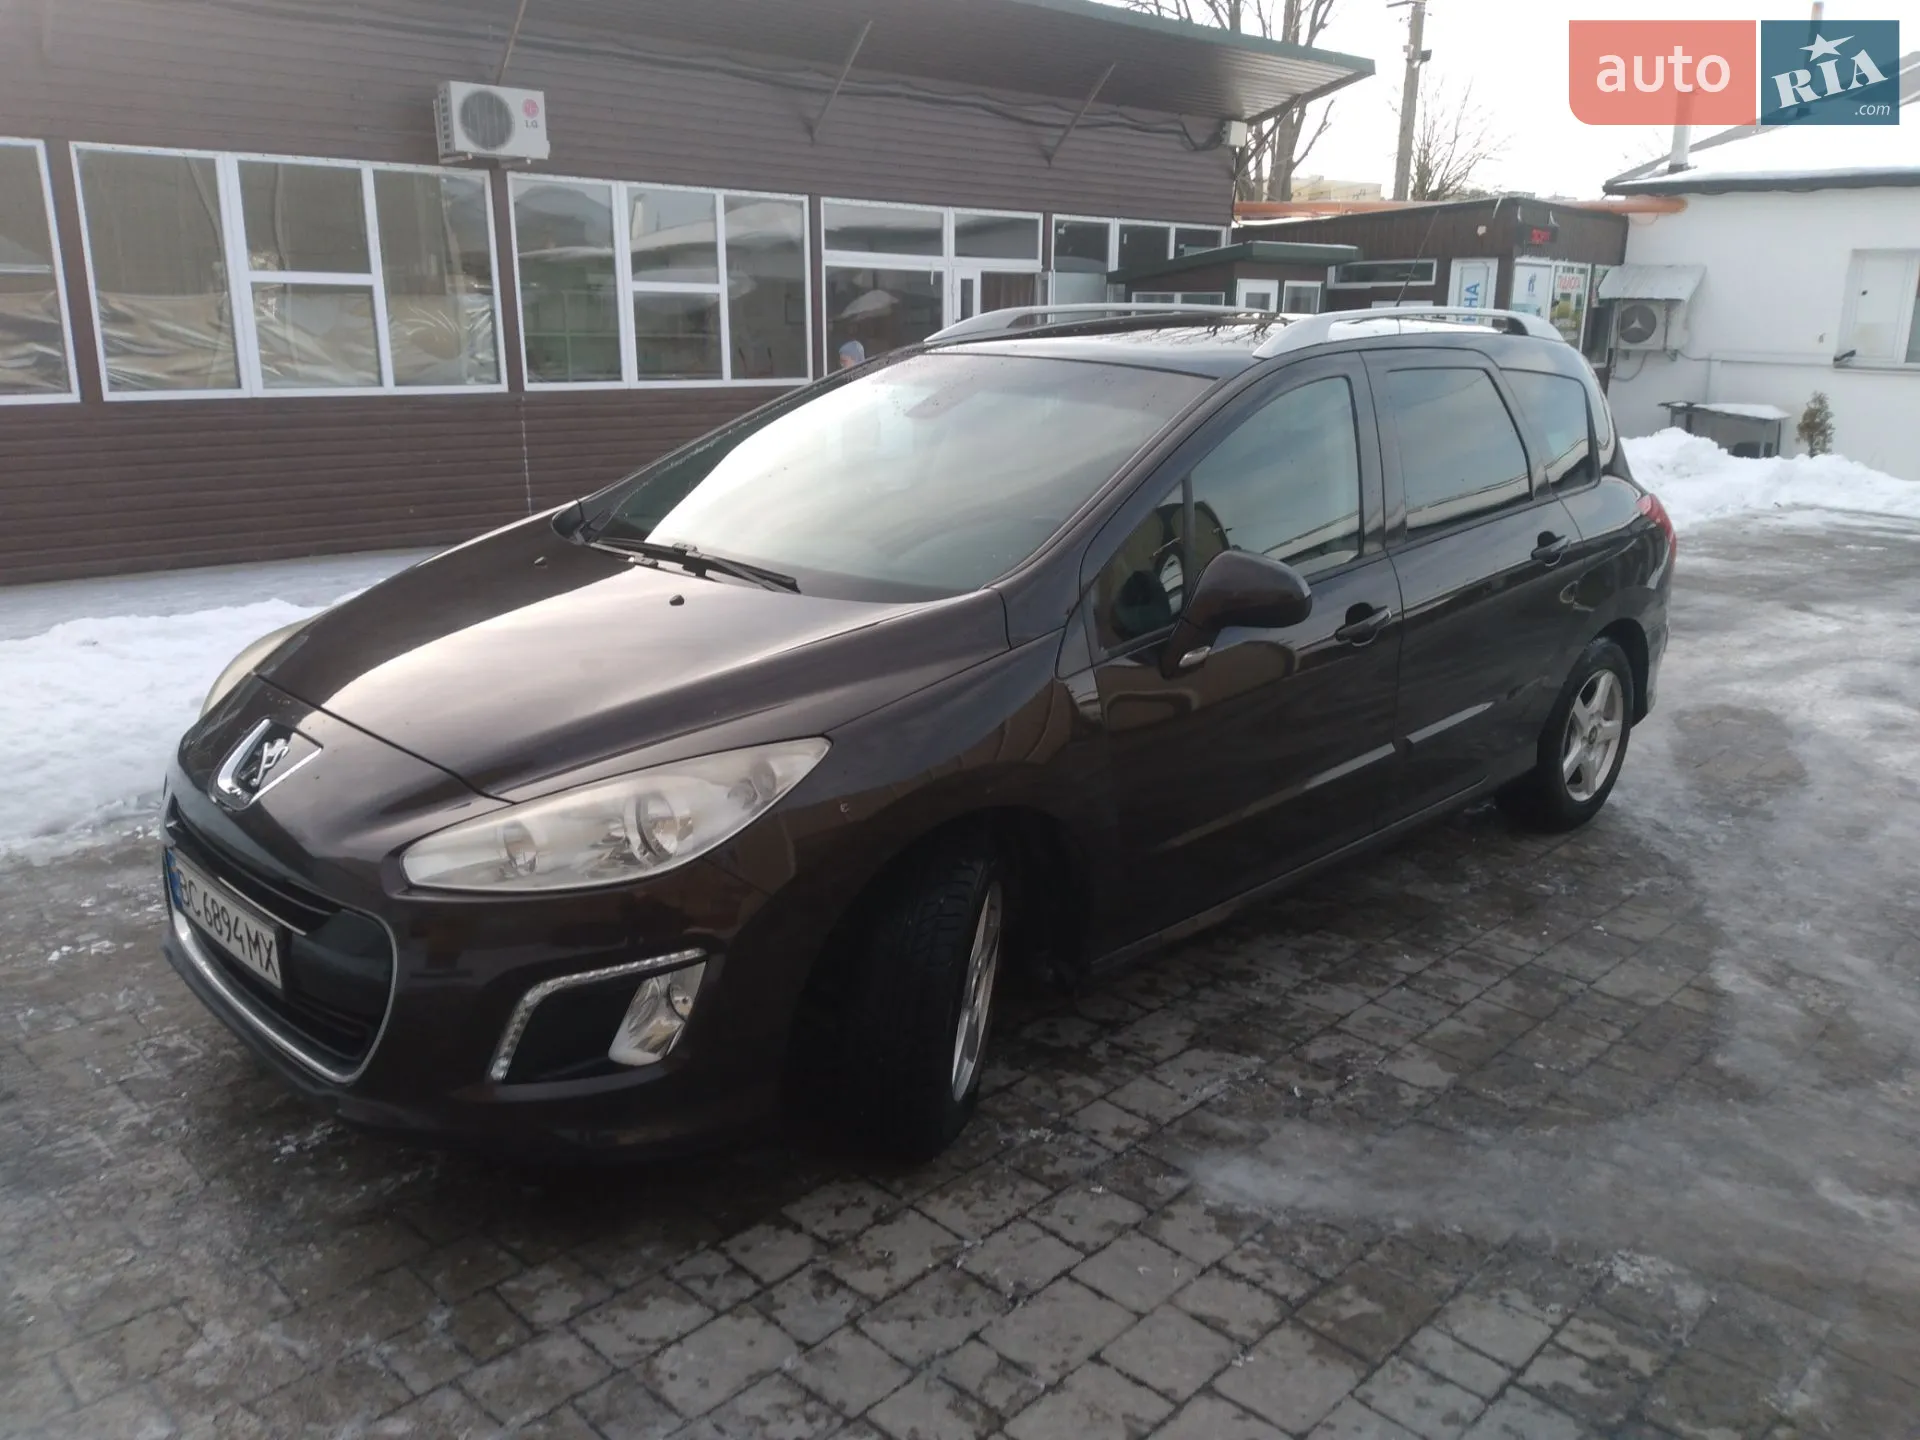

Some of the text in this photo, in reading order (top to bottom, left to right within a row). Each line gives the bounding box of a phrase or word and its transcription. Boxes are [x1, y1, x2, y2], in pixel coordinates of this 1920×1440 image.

[178, 868, 278, 980] BC 6894 MX
